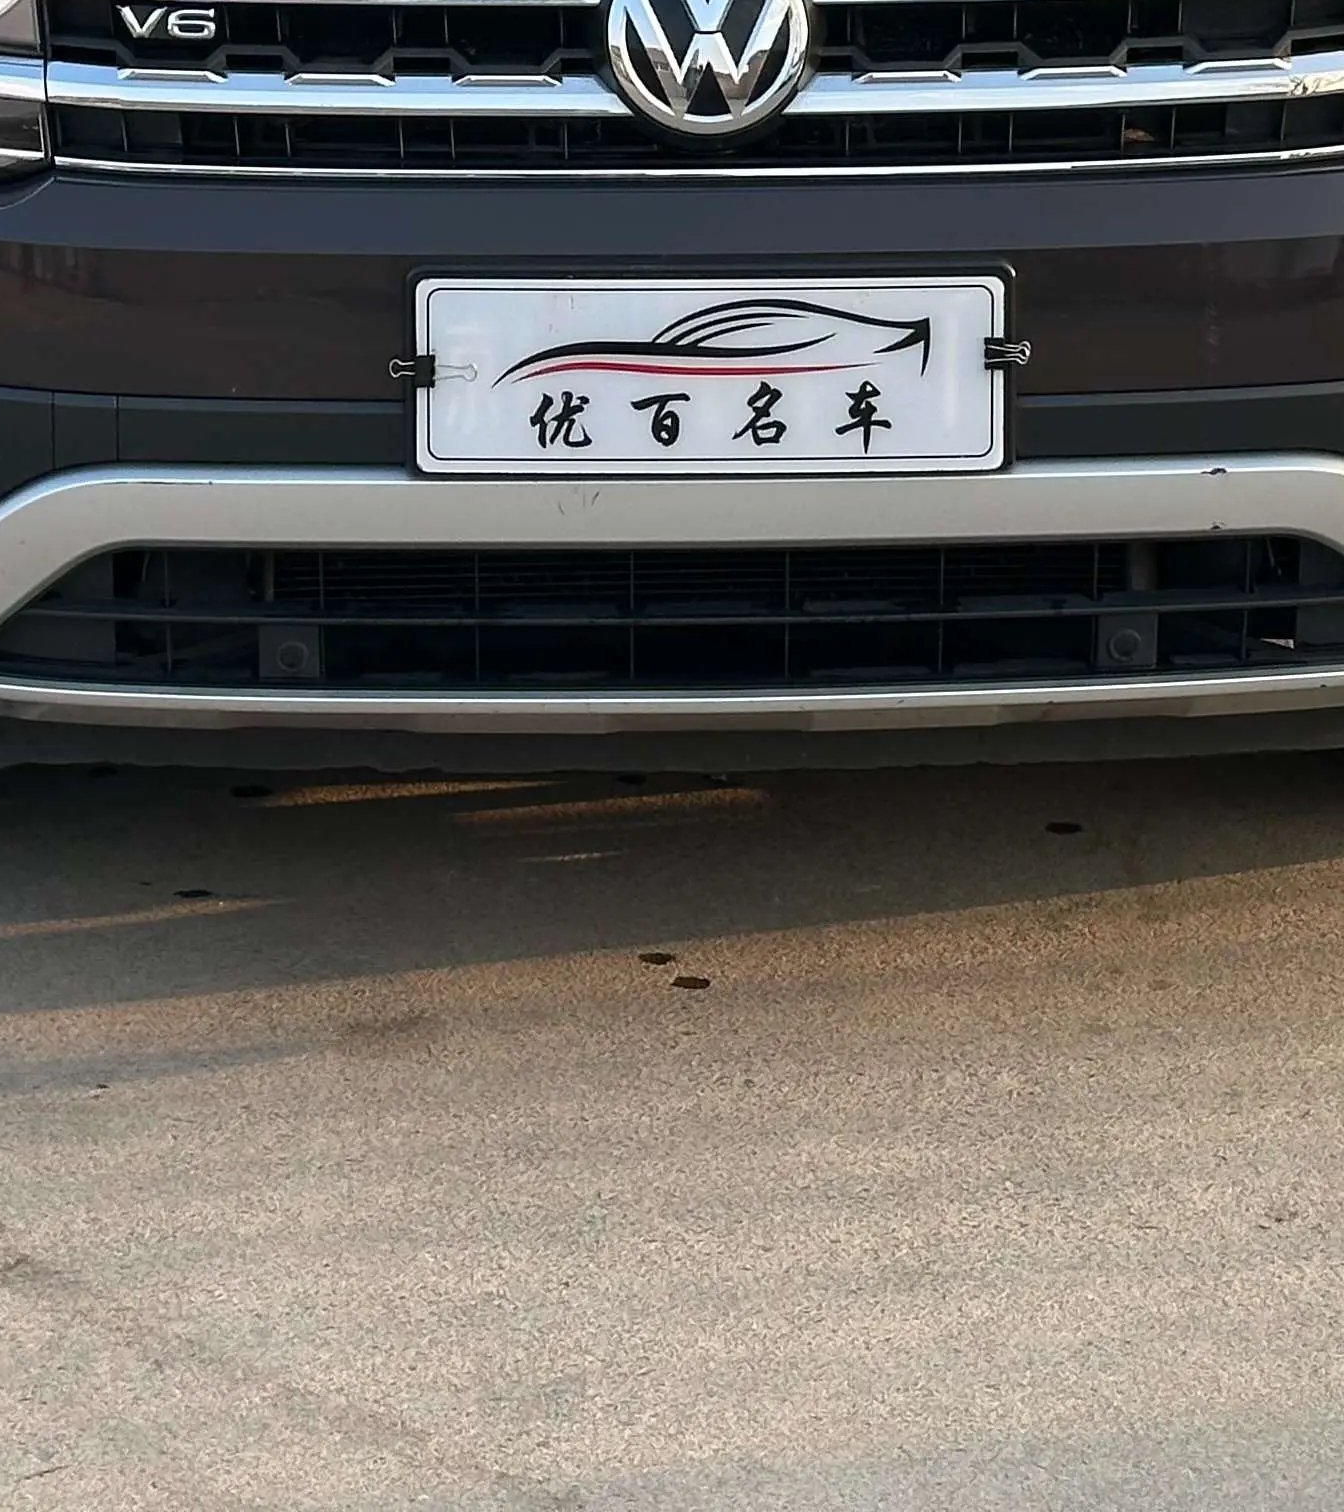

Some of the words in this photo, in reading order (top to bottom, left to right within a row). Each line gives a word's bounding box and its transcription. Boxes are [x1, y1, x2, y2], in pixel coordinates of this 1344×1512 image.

[115, 5, 217, 40] V6
[529, 381, 892, 455] 优百名车
